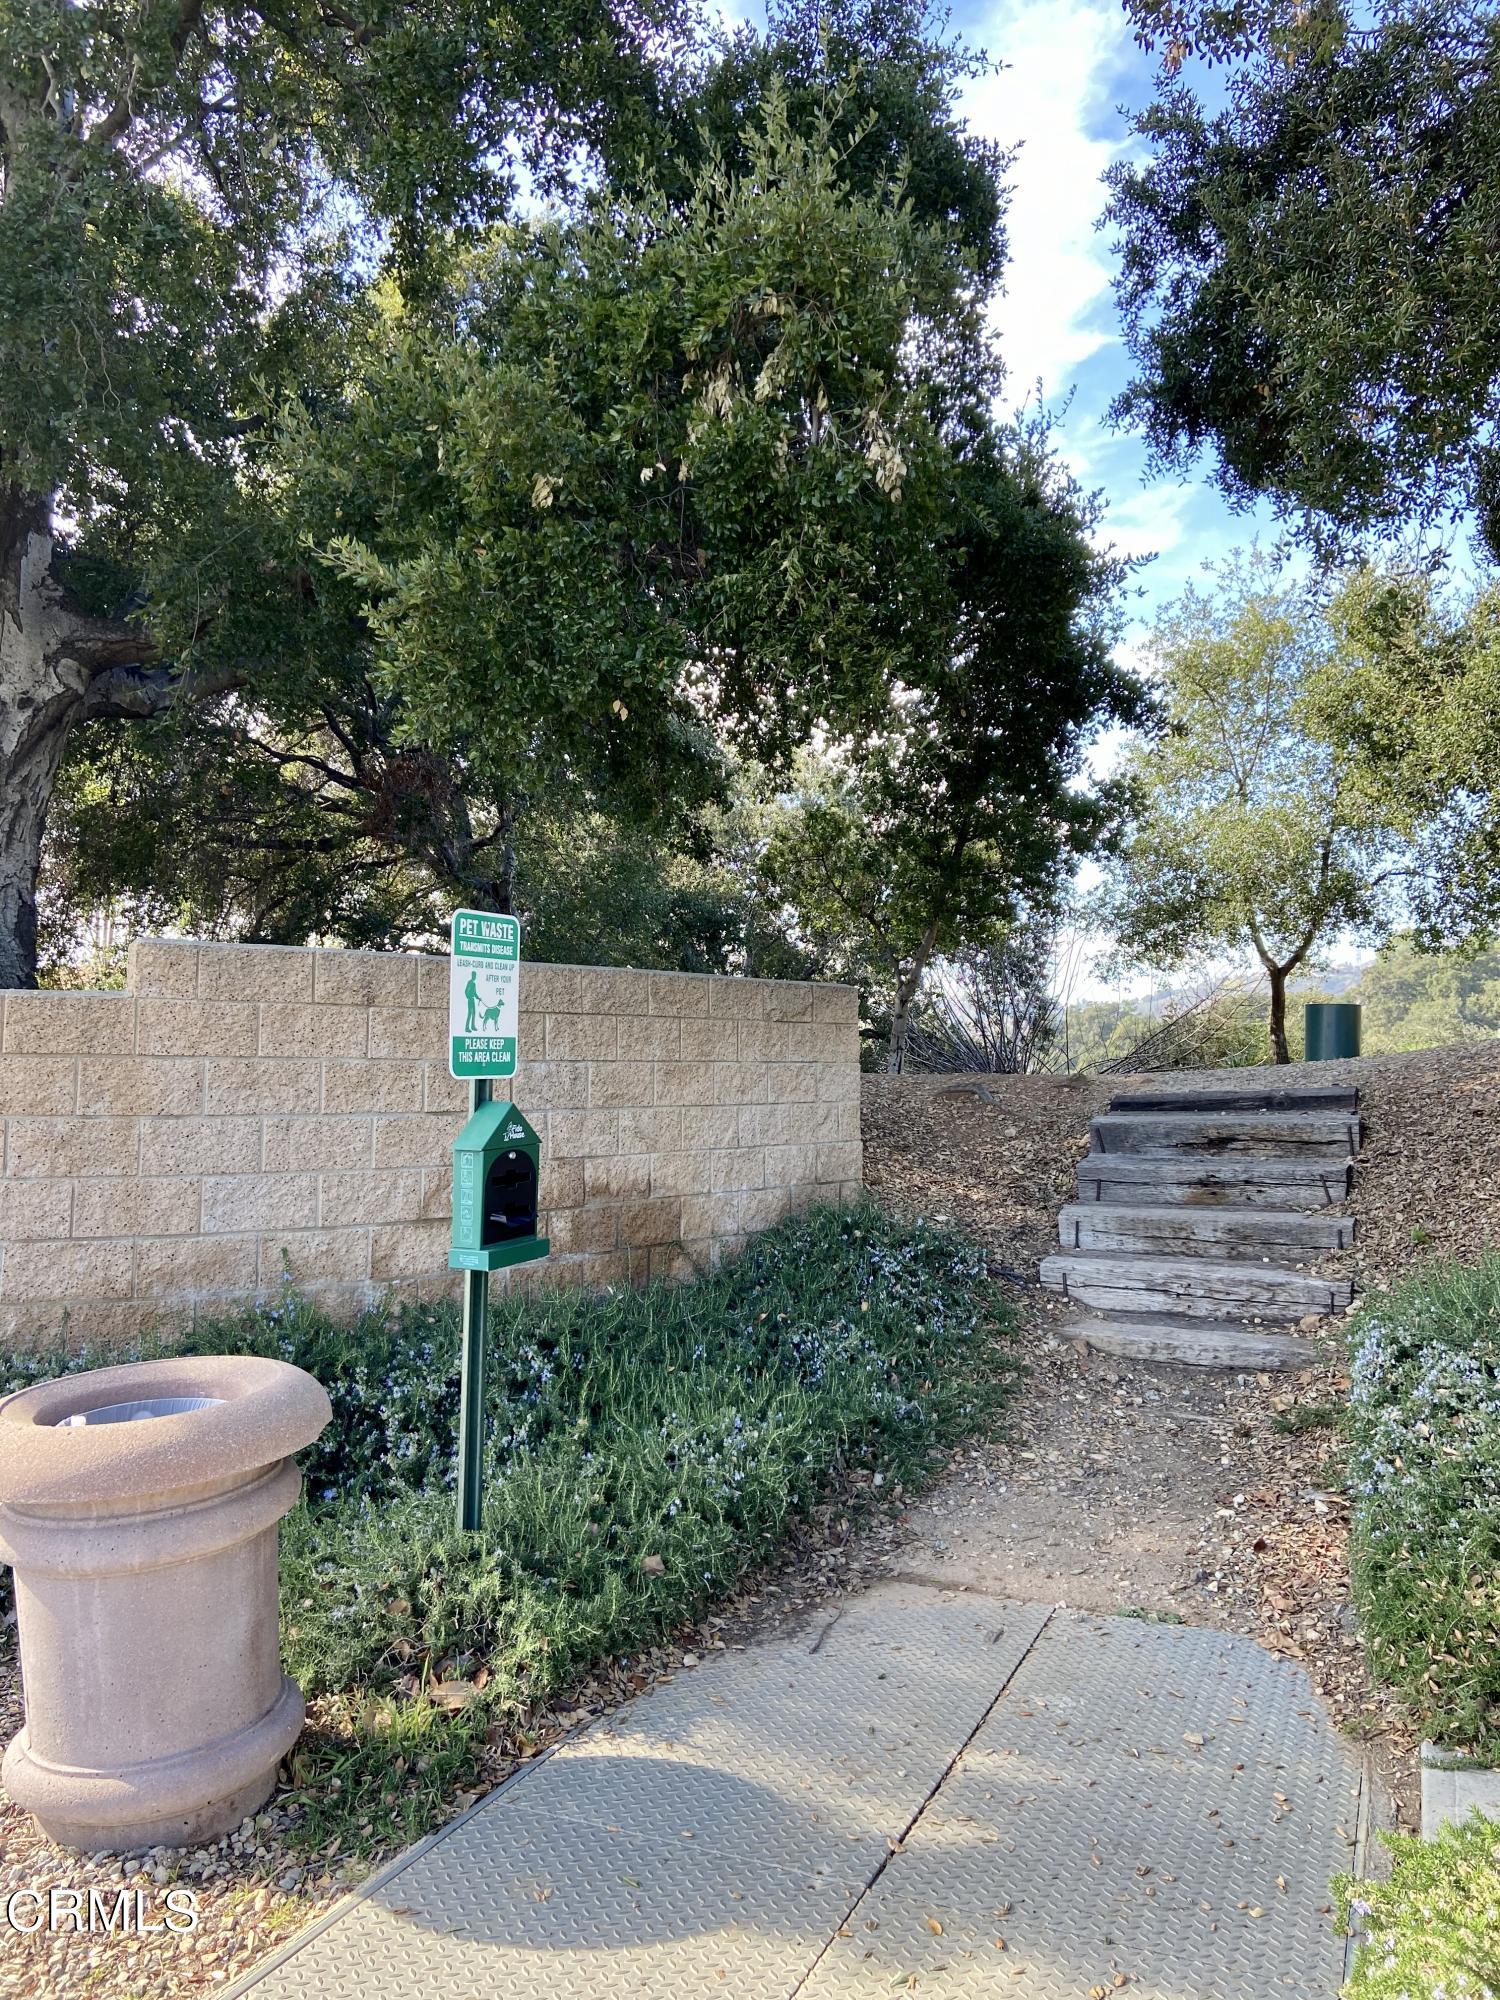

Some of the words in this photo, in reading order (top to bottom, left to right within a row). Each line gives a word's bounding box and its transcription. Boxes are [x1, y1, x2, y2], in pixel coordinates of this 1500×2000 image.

[459, 918, 478, 935] PET
[481, 921, 514, 940] WASTE
[460, 941, 491, 954] TRANSMITS
[492, 944, 513, 956] DISEASE
[485, 961, 494, 970] AND
[495, 962, 508, 971] CLEAN
[509, 963, 515, 972] UP
[486, 974, 499, 983] AFTER
[500, 975, 512, 983] YOUR
[496, 987, 505, 996] PET
[465, 1038, 488, 1050] PLEASE
[489, 1039, 504, 1050] KEEP
[459, 1051, 473, 1063] THIS
[474, 1051, 490, 1063] AREA
[491, 1052, 511, 1063] CLEAN
